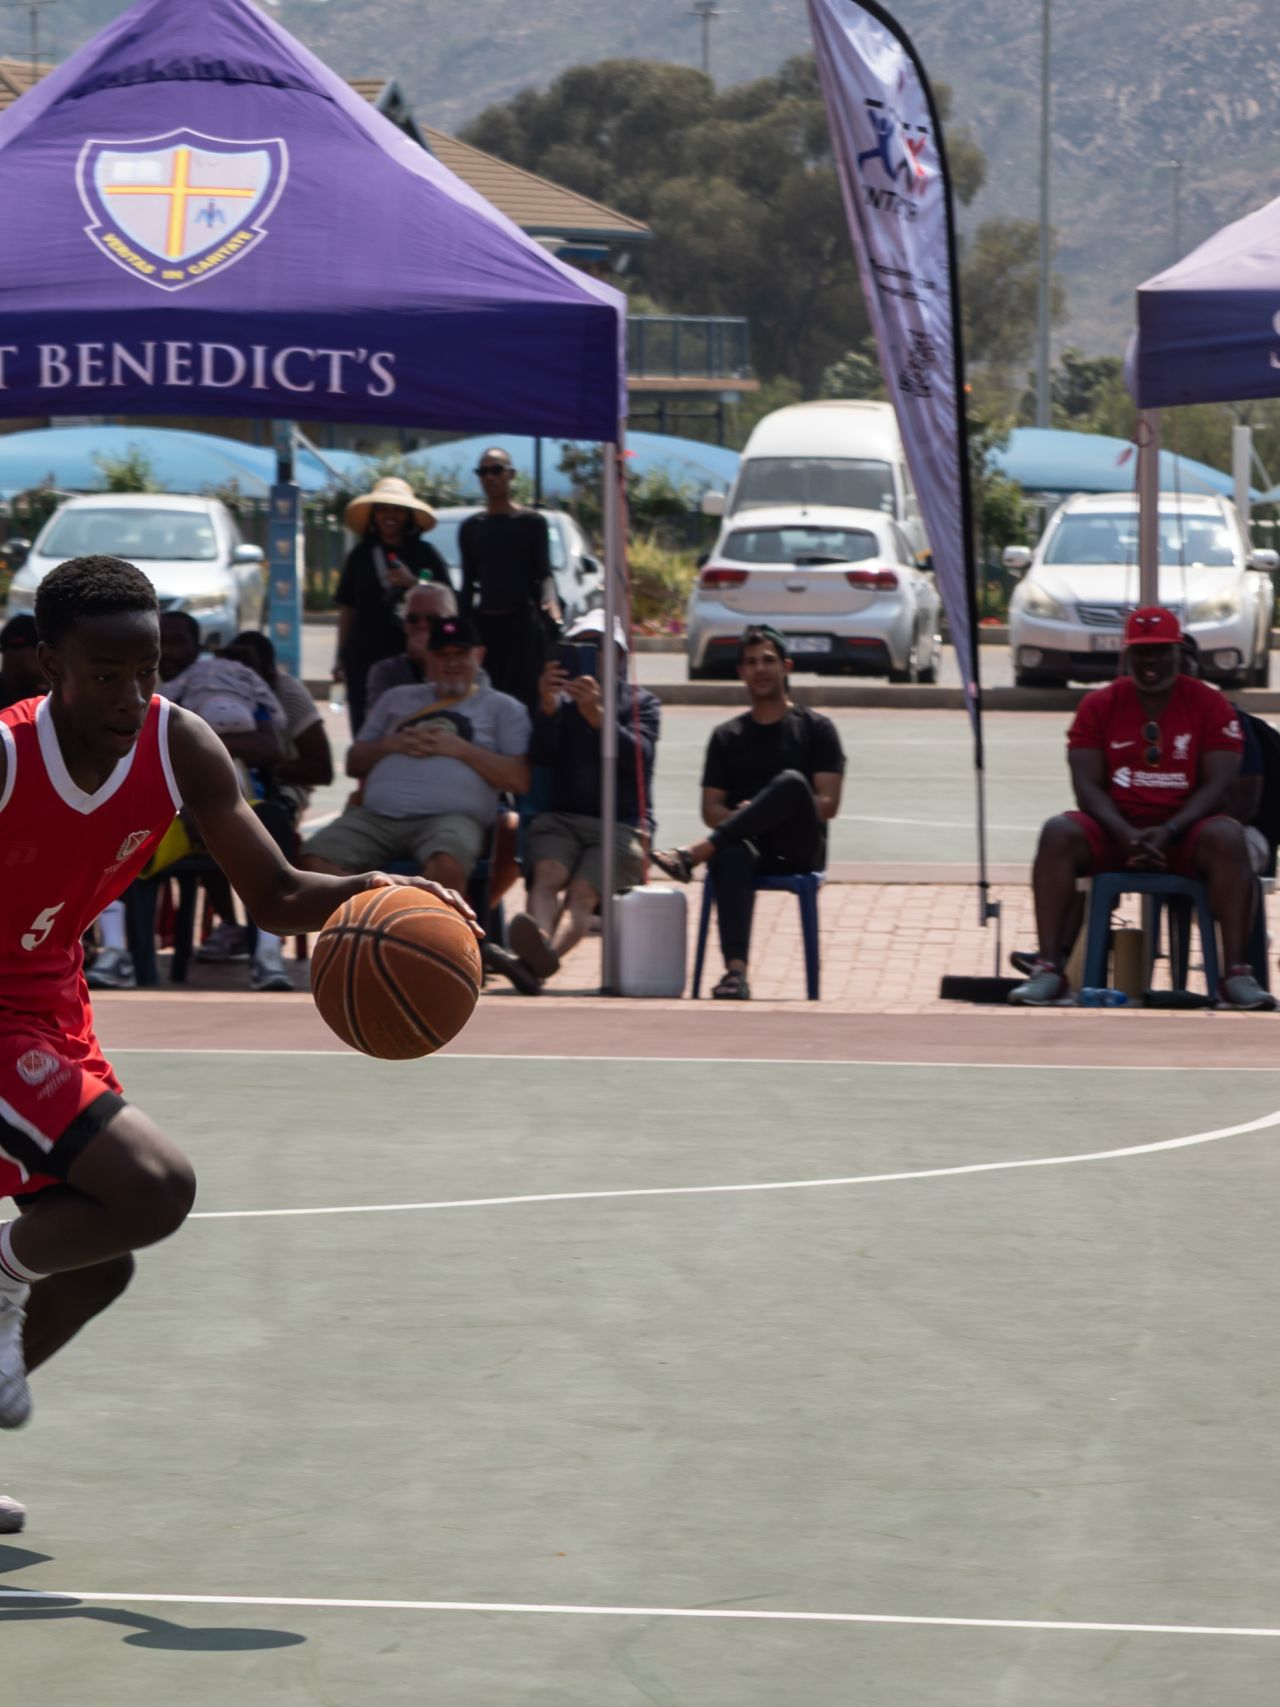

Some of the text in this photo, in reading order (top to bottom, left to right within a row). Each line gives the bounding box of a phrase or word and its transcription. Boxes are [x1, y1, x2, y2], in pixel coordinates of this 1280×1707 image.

[102, 233, 156, 274] VERITAS
[187, 230, 253, 275] CARITATE
[37, 341, 396, 397] BENEDICT'S
[21, 901, 65, 951] 5
